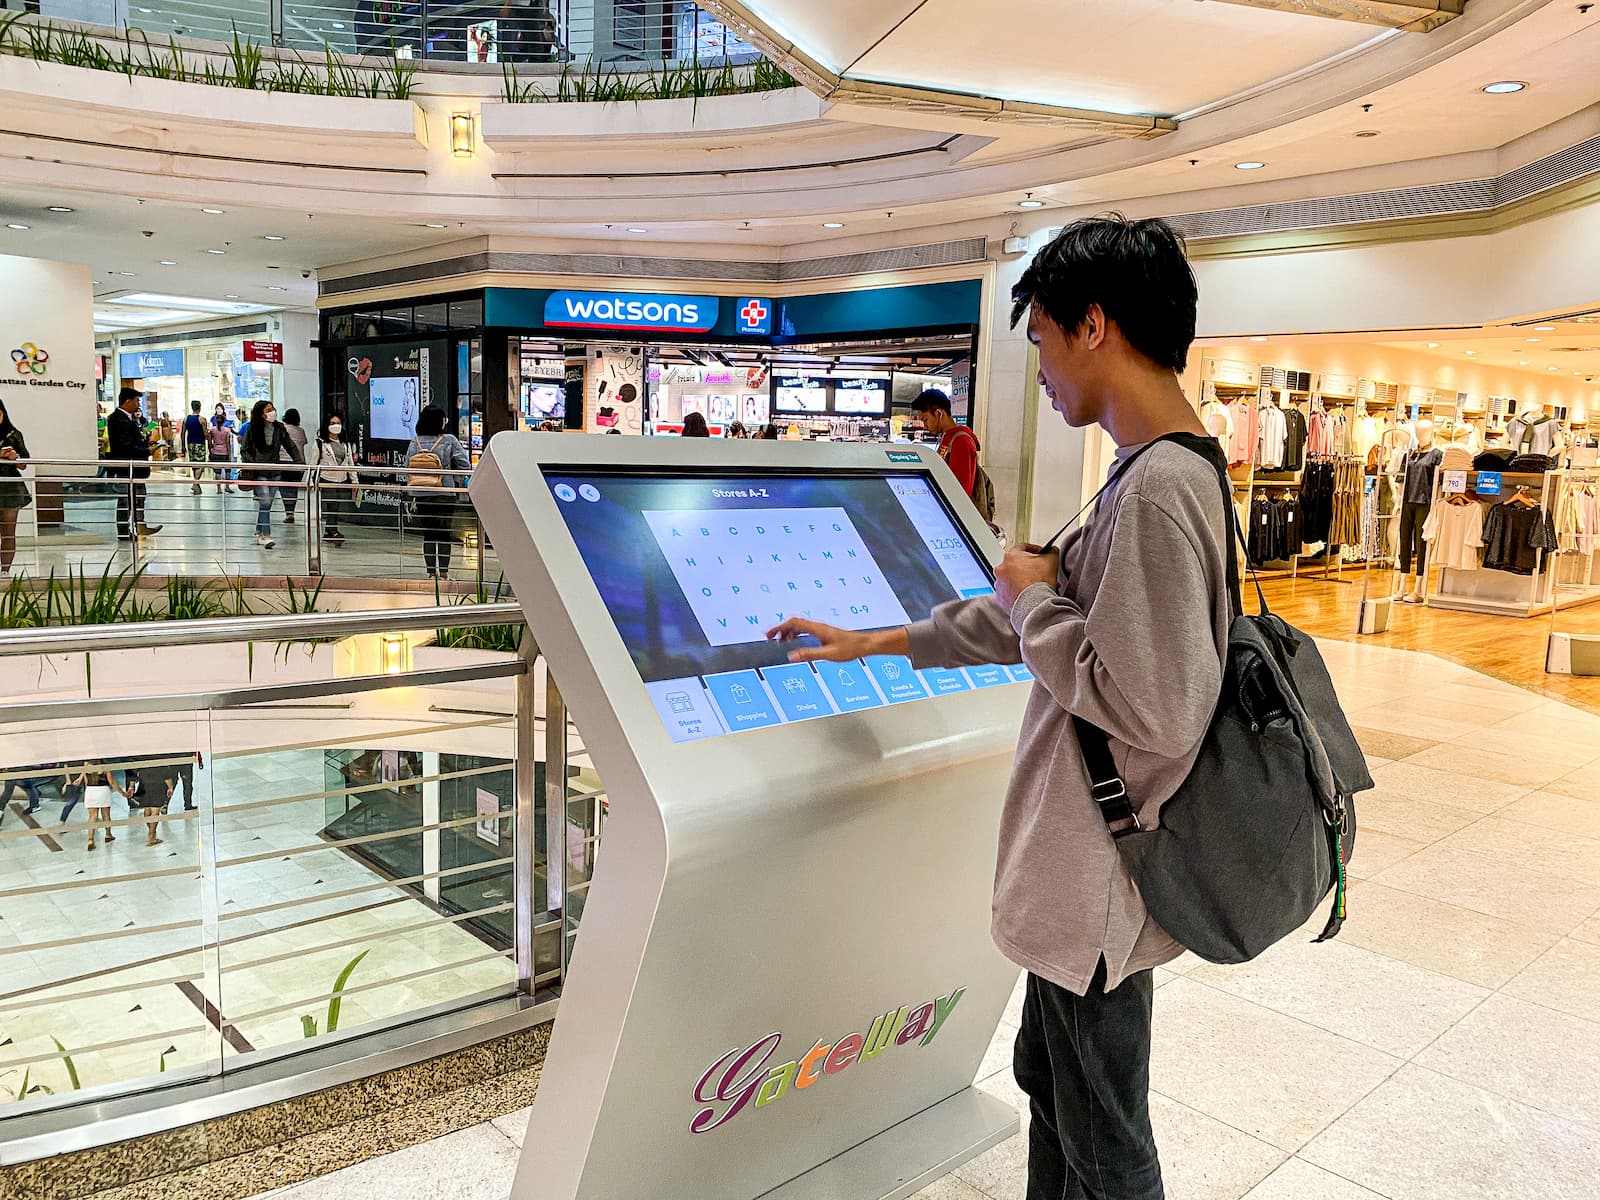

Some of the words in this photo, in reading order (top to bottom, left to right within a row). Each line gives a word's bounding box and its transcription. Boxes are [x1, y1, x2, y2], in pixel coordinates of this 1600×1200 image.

[565, 297, 698, 323] watsons
[29, 379, 64, 388] Garden
[65, 380, 87, 390] City
[711, 488, 748, 498] Stores
[749, 488, 769, 498] A-Z
[700, 528, 710, 536] B
[729, 527, 738, 535] C
[755, 526, 765, 535] D
[783, 525, 792, 534] E
[808, 524, 816, 532] F
[832, 523, 842, 532] G
[685, 558, 697, 567] H
[771, 553, 781, 562] K
[822, 551, 833, 559] M
[847, 550, 857, 558] N
[702, 587, 712, 596] O
[731, 585, 740, 595] P
[787, 582, 798, 591] R
[814, 580, 823, 588] S
[838, 577, 846, 586] T
[863, 576, 872, 585] U
[716, 618, 727, 628] V
[745, 615, 759, 625] W
[796, 702, 818, 712] Dining
[735, 711, 768, 722] Shopping
[678, 719, 702, 728] Stores
